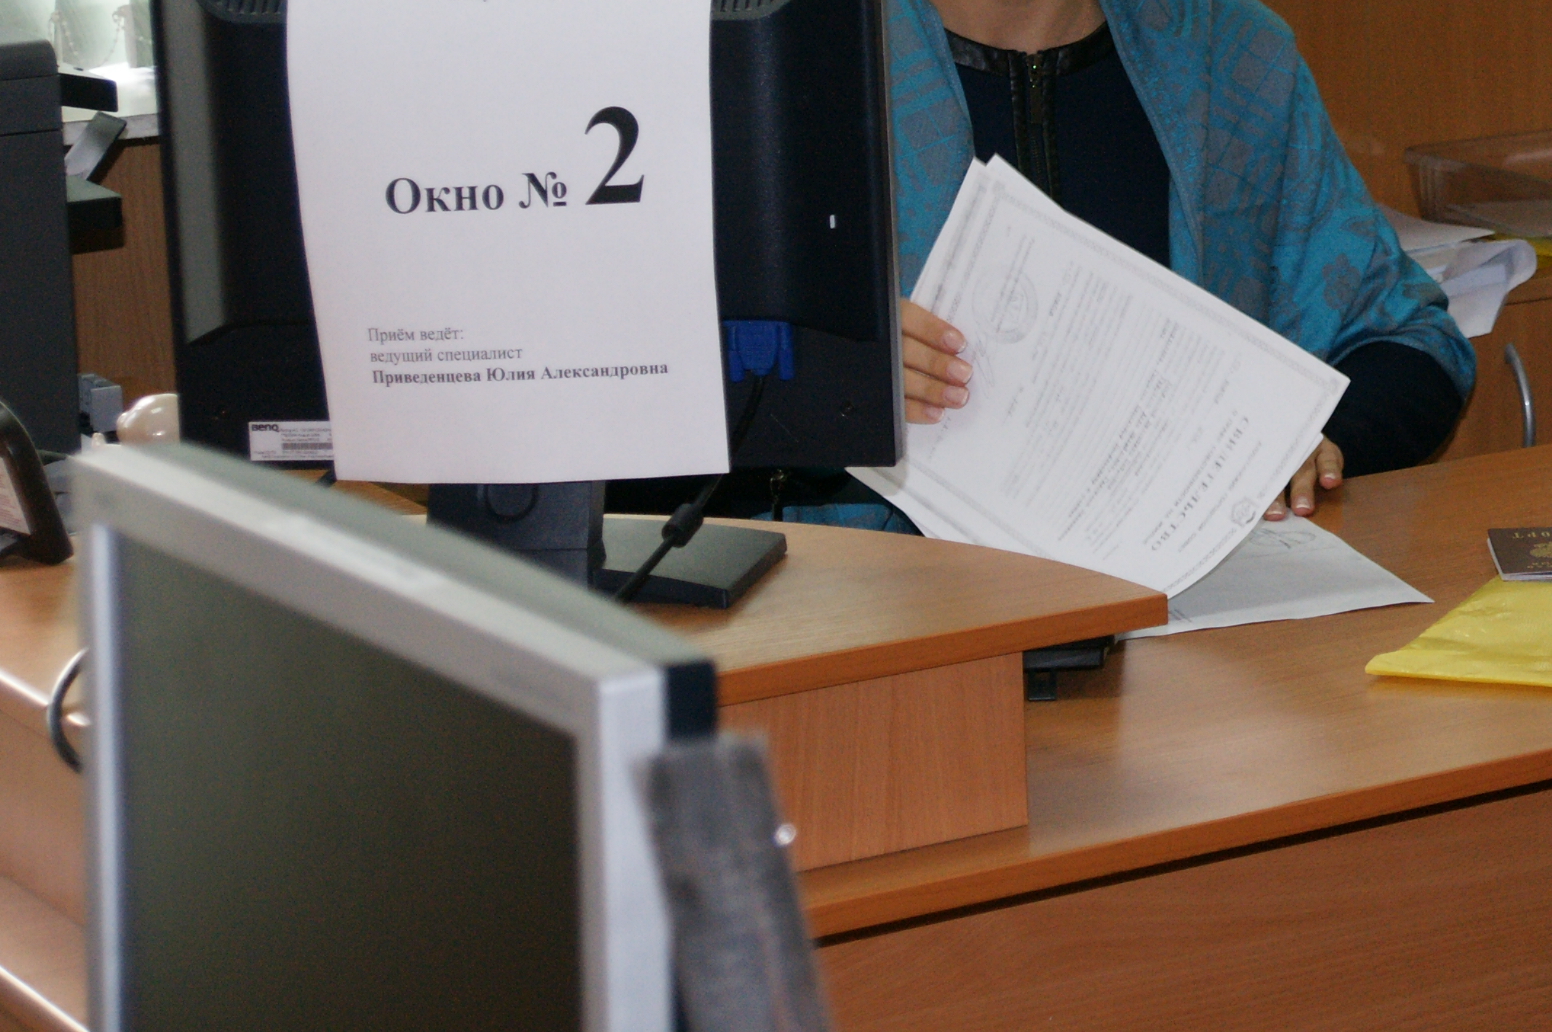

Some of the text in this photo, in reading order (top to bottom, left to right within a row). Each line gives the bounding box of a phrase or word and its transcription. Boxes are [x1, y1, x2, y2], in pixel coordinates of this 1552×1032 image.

[385, 105, 645, 215] Окно № 2
[367, 326, 464, 346] Приём ведёт:
[370, 348, 523, 366] ведущий специалист
[372, 363, 669, 388] Приведенцева Юлия Александровна
[251, 424, 280, 432] BenQ
[1149, 415, 1251, 553] СВИДЕТЕЛЬСТВО
